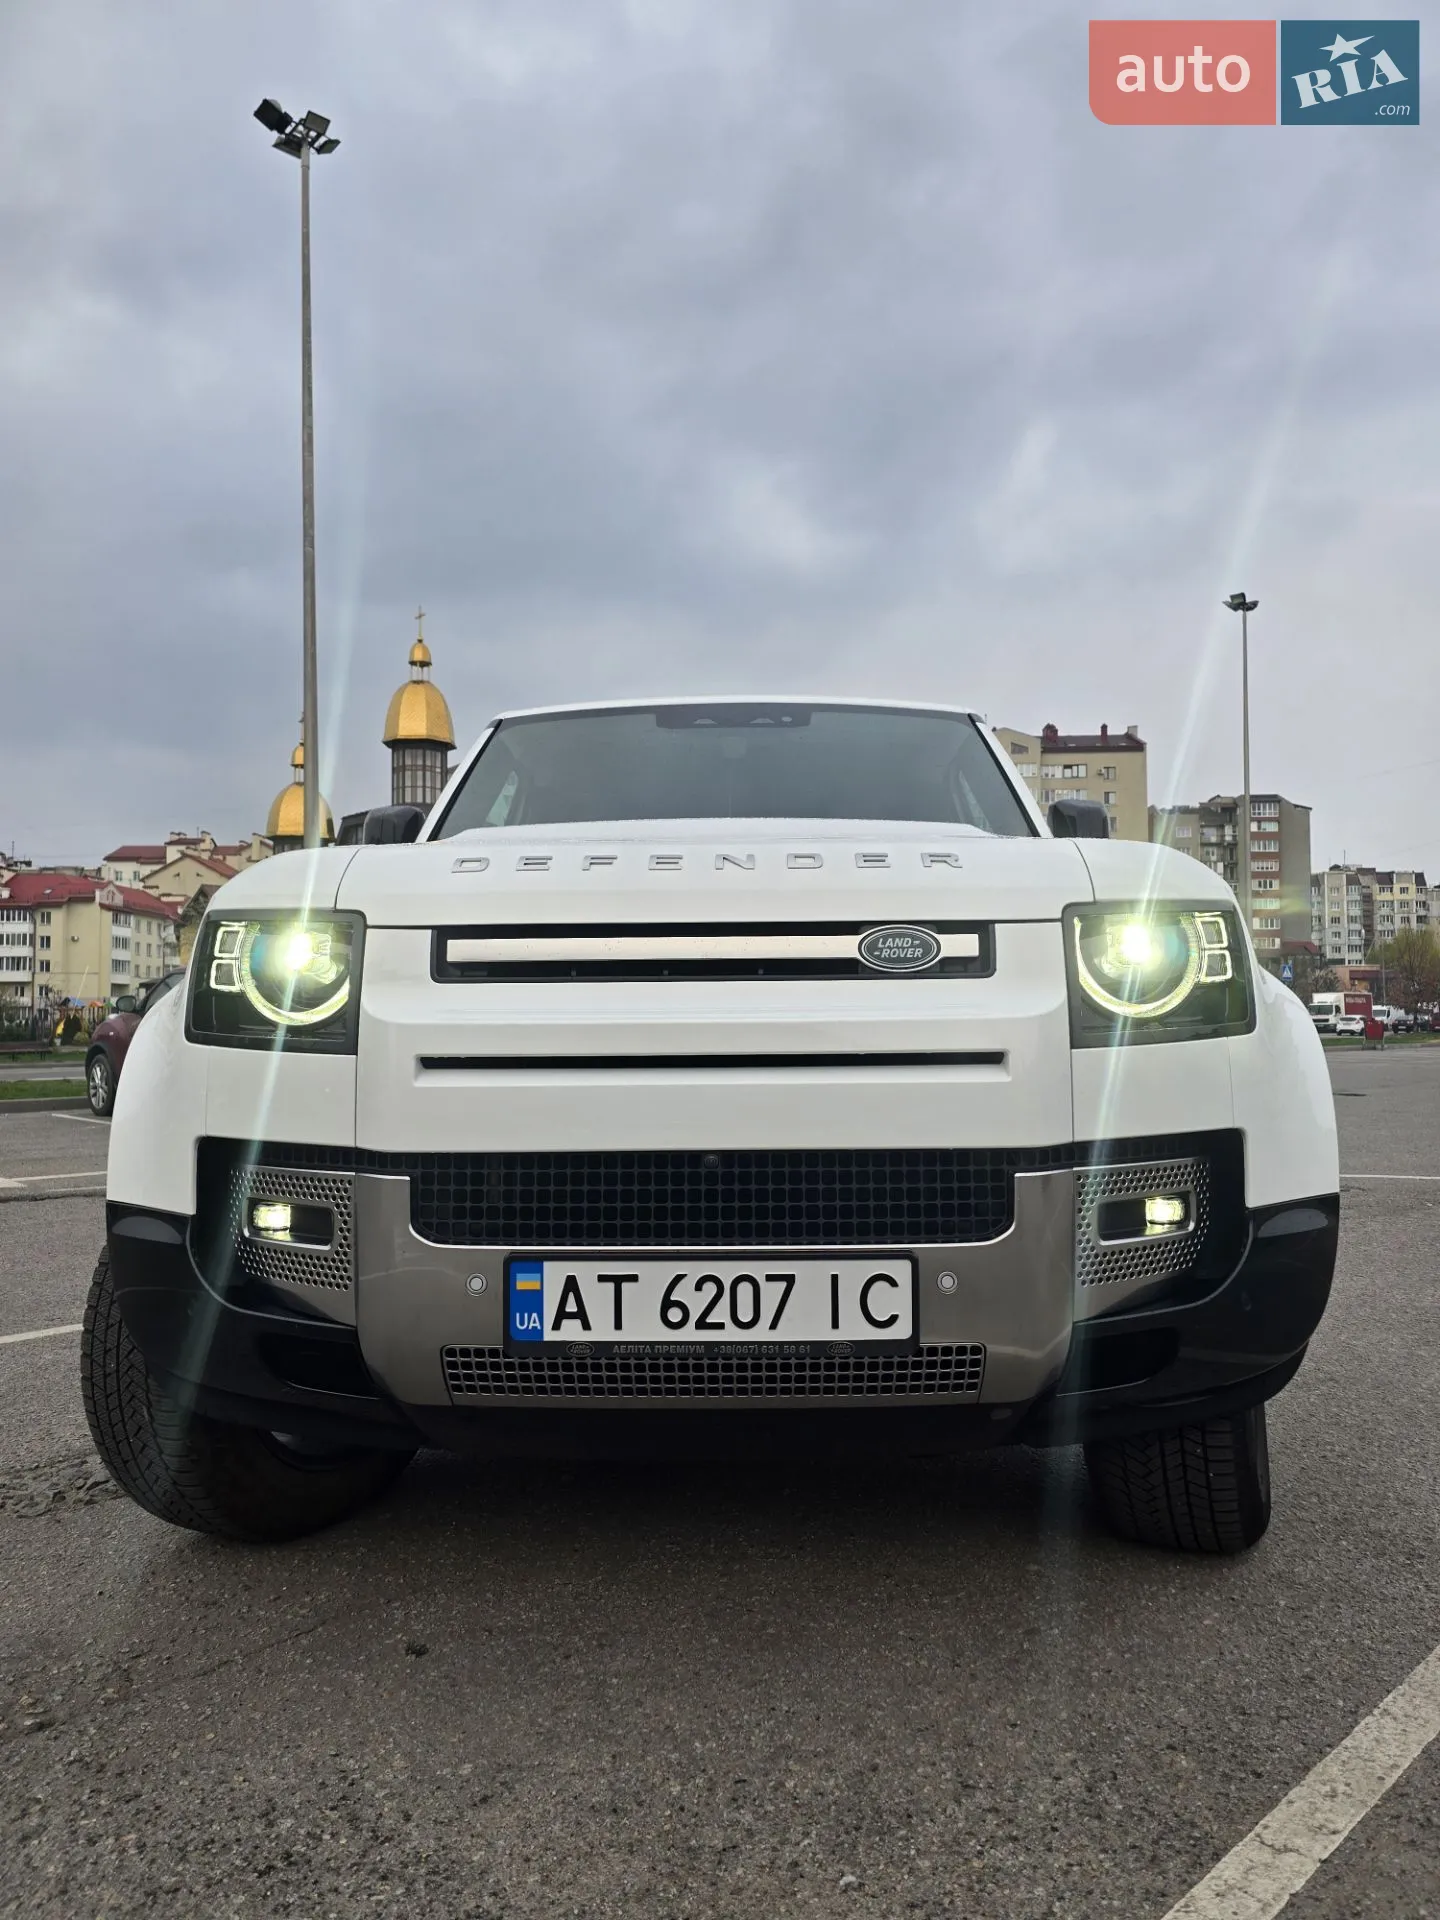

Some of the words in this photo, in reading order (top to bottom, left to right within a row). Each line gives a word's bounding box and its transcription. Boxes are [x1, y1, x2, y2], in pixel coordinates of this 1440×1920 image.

[451, 852, 963, 874] DEFENDER
[551, 1273, 639, 1331] AT
[660, 1273, 796, 1330] 6207
[830, 1272, 900, 1330] IC
[515, 1312, 541, 1330] UA
